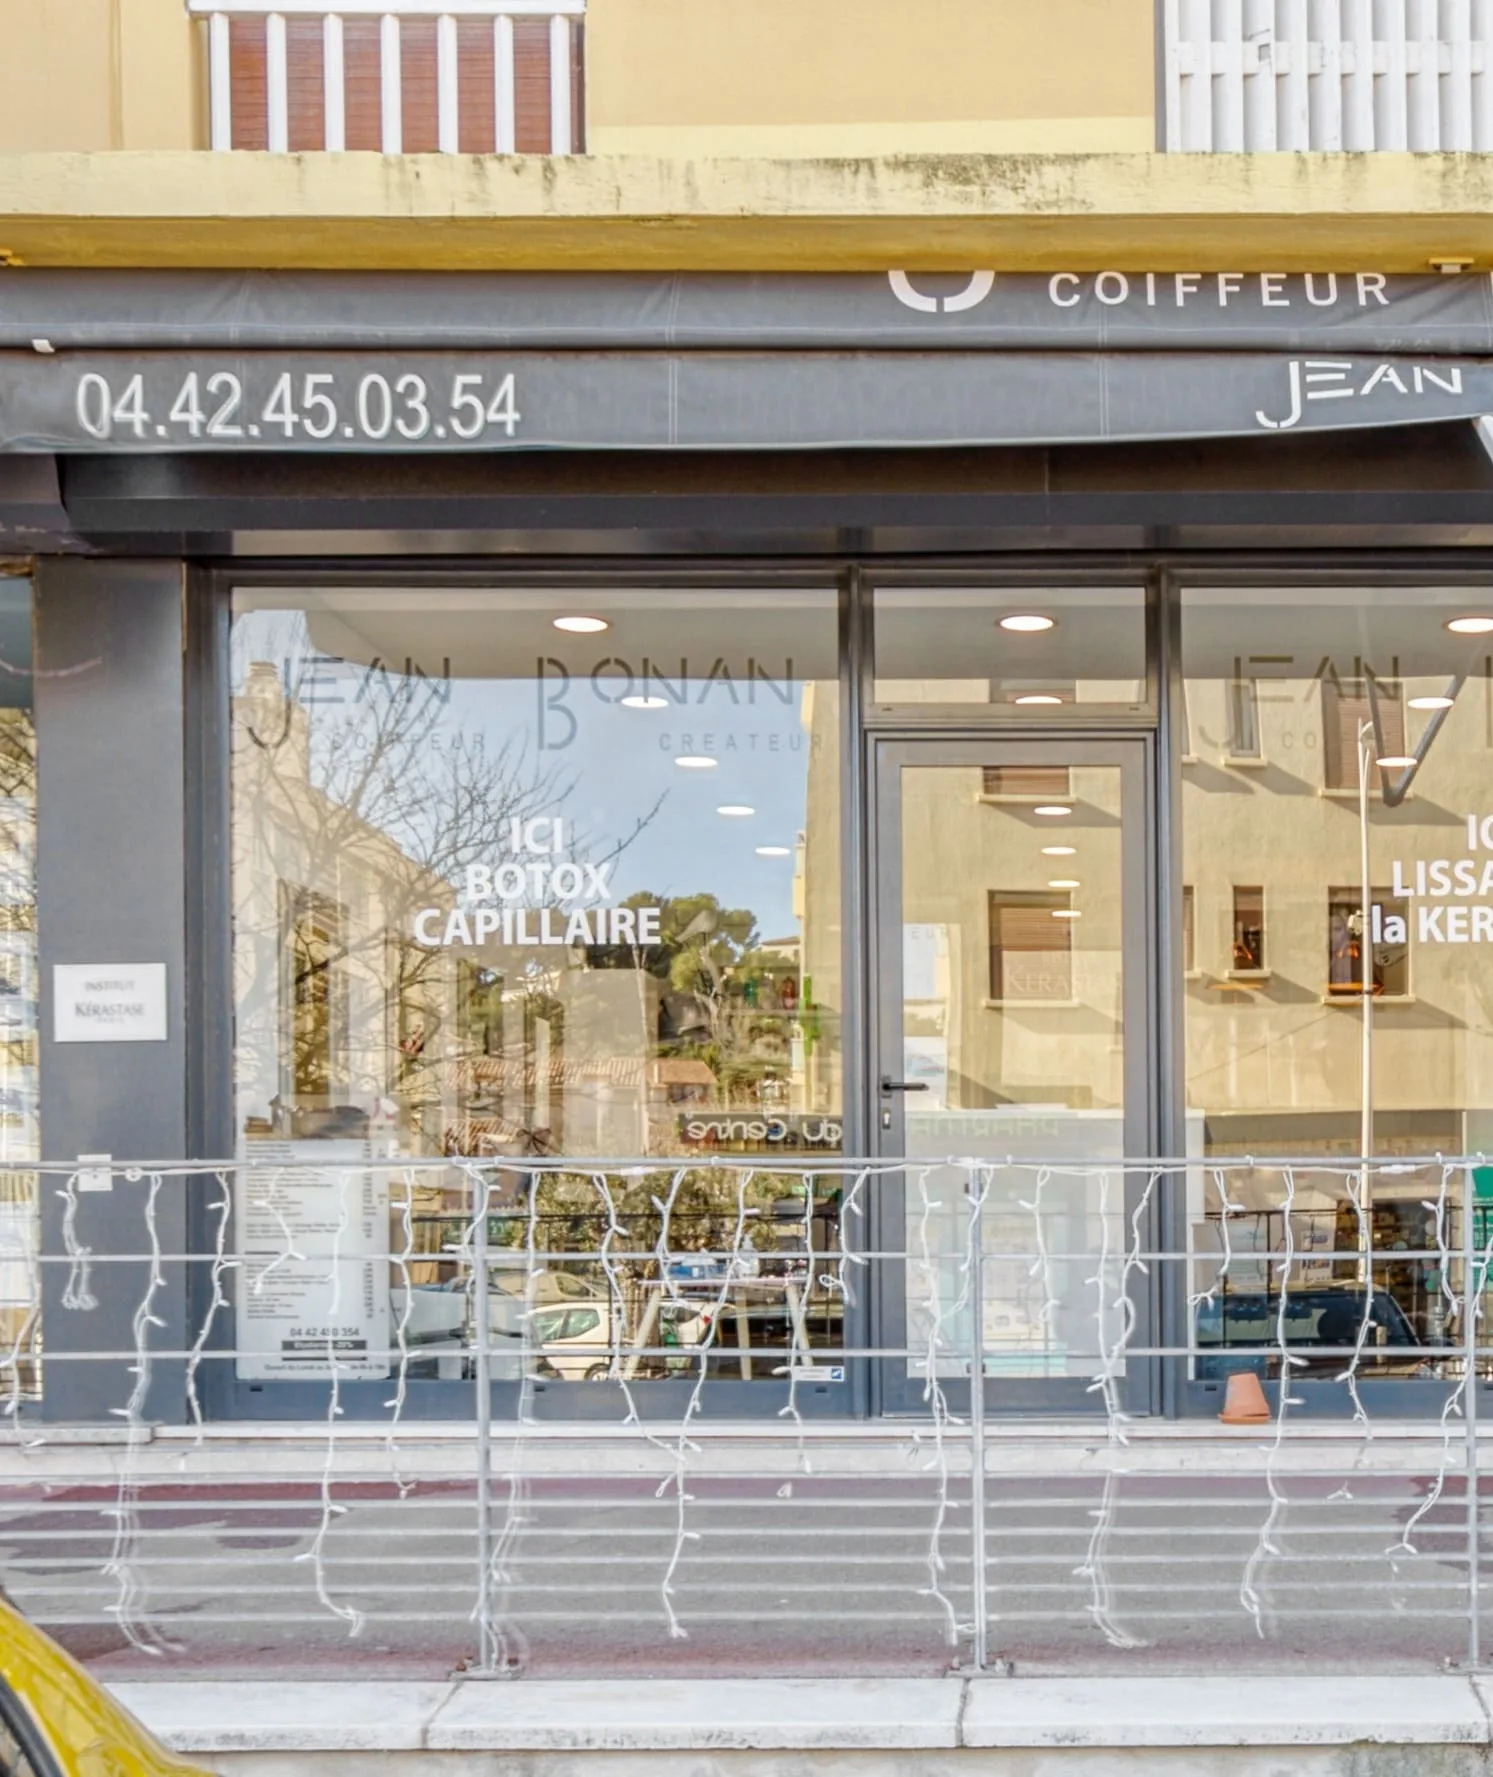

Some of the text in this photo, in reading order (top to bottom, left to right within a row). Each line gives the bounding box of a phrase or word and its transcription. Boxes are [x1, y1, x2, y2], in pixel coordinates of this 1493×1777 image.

[1048, 271, 1390, 307] COIFFEUR
[77, 371, 521, 439] 04.42.45.03.54
[1256, 360, 1463, 428] JEAN
[245, 656, 794, 750] JEAN BONAN
[1199, 655, 1400, 748] JEAN
[511, 816, 563, 854] ICI
[467, 863, 611, 901] BOTOX
[414, 907, 661, 946] CAPILLAIRE
[1372, 906, 1406, 944] la
